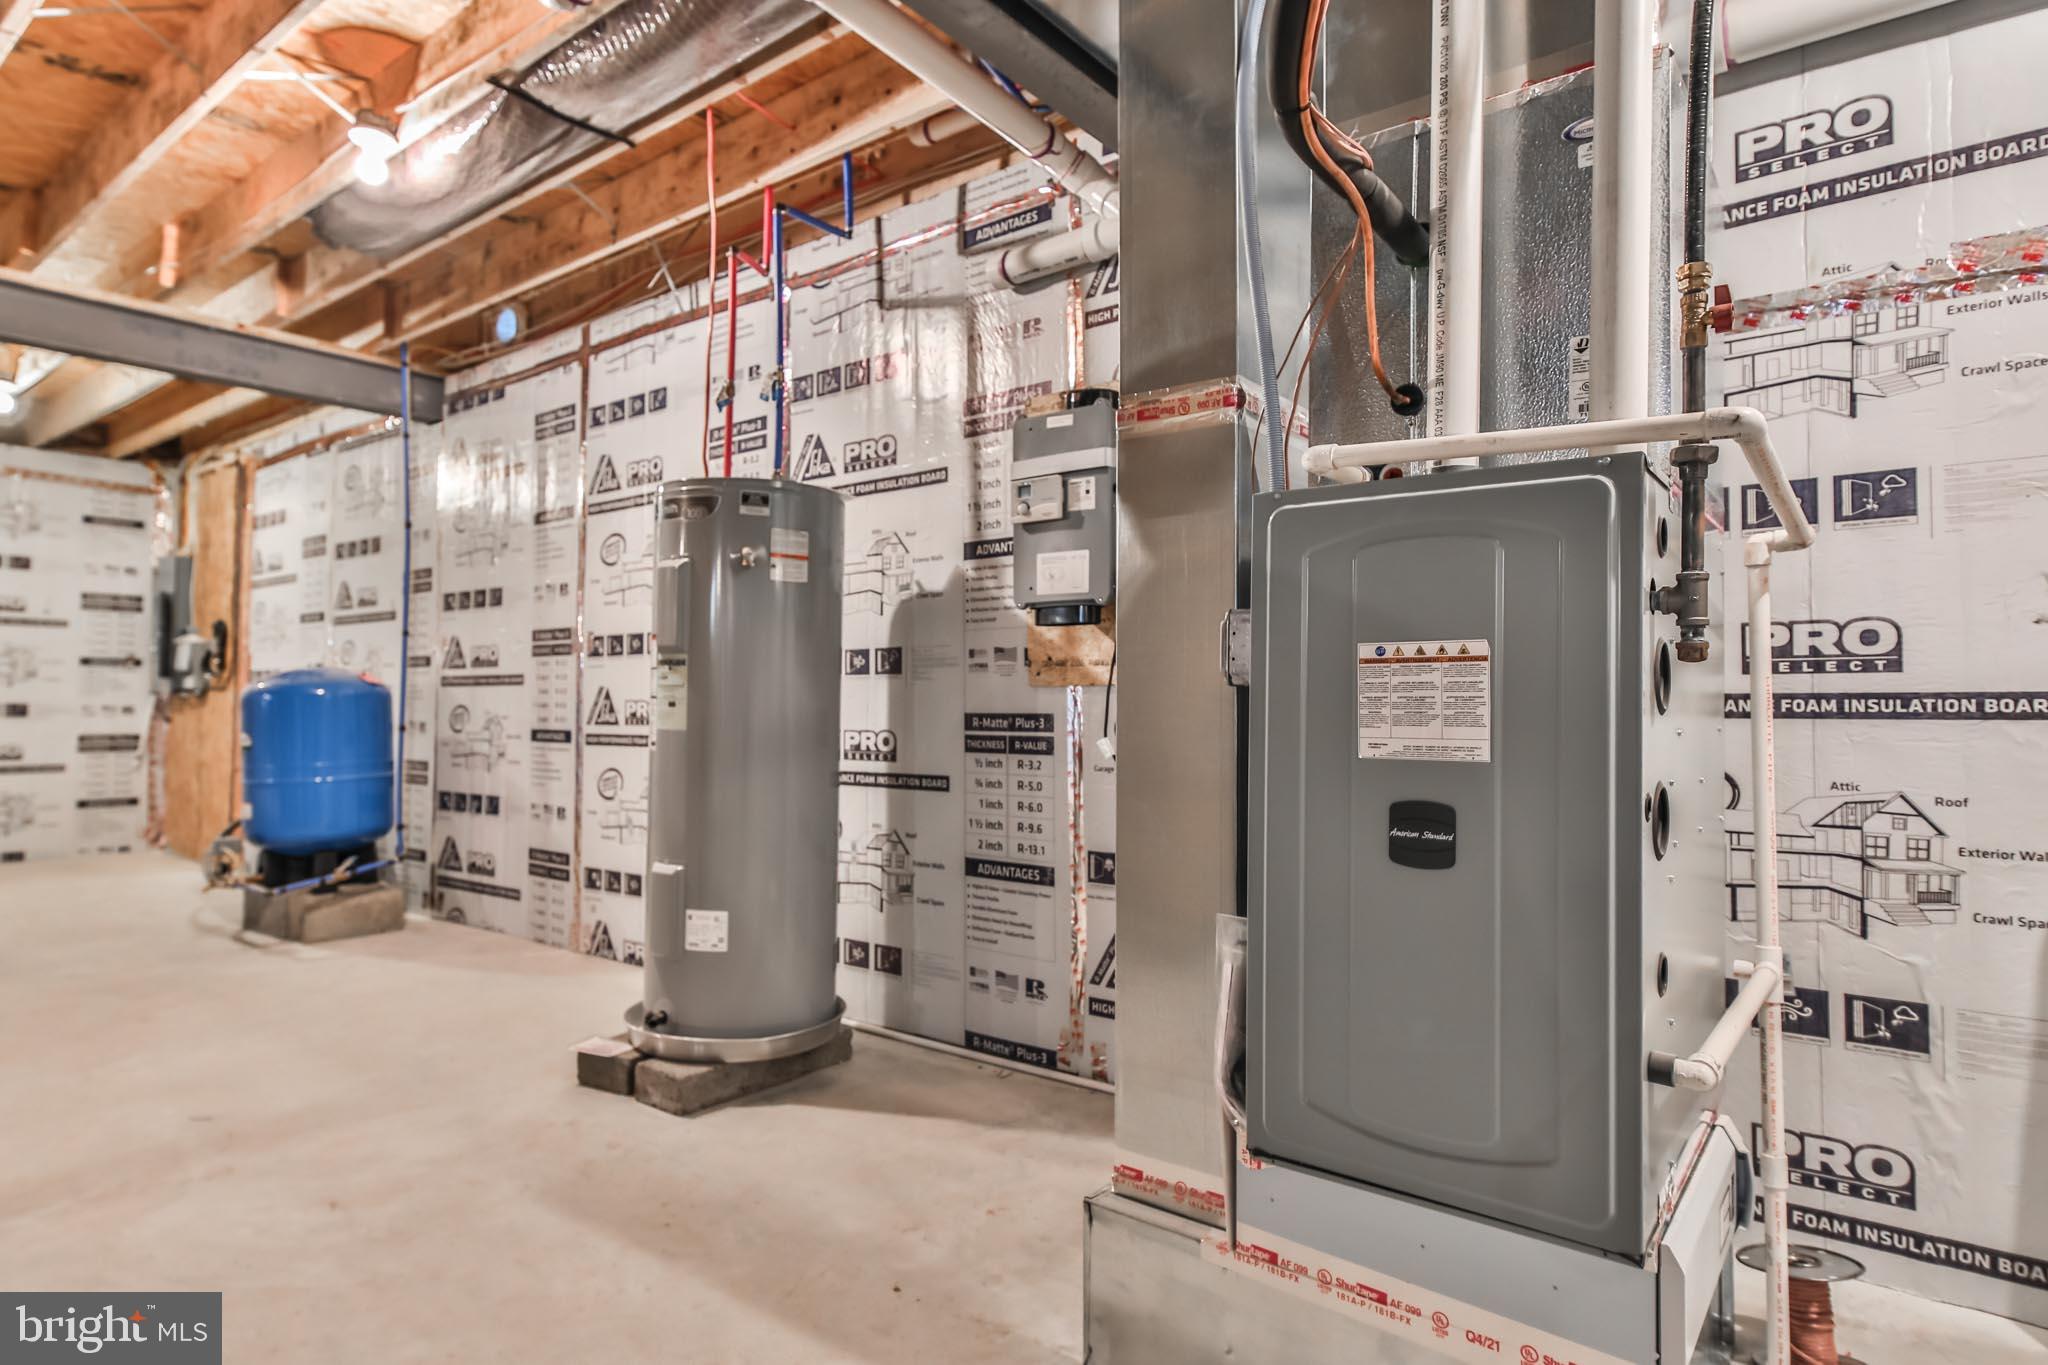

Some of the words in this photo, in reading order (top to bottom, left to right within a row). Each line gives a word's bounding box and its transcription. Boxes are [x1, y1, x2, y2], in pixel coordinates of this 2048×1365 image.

[1737, 95, 1893, 166] PRO
[1748, 137, 1879, 179] SELECT
[1773, 185, 1829, 212] FOAM
[1834, 152, 1967, 198] INSULATION
[976, 210, 1039, 241] ADVANTAGES
[1437, 240, 1447, 256] NSF
[1822, 262, 1853, 277] Attic
[1947, 298, 2002, 316] Exterior
[2006, 290, 2048, 305] Walls
[1087, 309, 1111, 325] HIGH
[1961, 361, 2000, 378] Crawl
[2005, 357, 2048, 374] Space
[844, 434, 897, 463] PRO
[627, 456, 662, 480] PRO
[1778, 660, 1888, 672] ELECT
[1781, 699, 1837, 713] FOAM
[1844, 698, 1976, 713] INSULATION
[1015, 717, 1045, 730] Plus-3
[844, 730, 896, 751] PRO
[1015, 740, 1048, 751] R-VALUE
[985, 758, 1003, 768] inch
[1017, 760, 1042, 771] R-3.2
[985, 779, 1003, 789] inch
[1017, 780, 1043, 792] R-5.0
[1830, 781, 1861, 792] Attic
[985, 800, 1003, 810] inch
[1017, 801, 1043, 813] R-6.0
[1935, 796, 1969, 808] Roof
[985, 820, 1003, 831] inch
[1017, 822, 1043, 834] R-9.6
[1389, 827, 1419, 838] American
[1421, 831, 1455, 841] Standard
[985, 841, 1003, 852] inch
[1017, 843, 1045, 855] R-13.1
[1958, 846, 2015, 861] Exterior
[977, 862, 1041, 881] ADVANTAGES
[1973, 912, 2013, 927] Crawl
[1091, 1002, 1115, 1014] HIGH
[1016, 1046, 1048, 1064] Plus-3
[1790, 1171, 1901, 1205] ELECT
[1792, 1210, 1849, 1236] FOAM
[1856, 1223, 1991, 1270] INSULATION
[1390, 1298, 1403, 1310] AF
[1465, 1329, 1500, 1353] Q4/21
